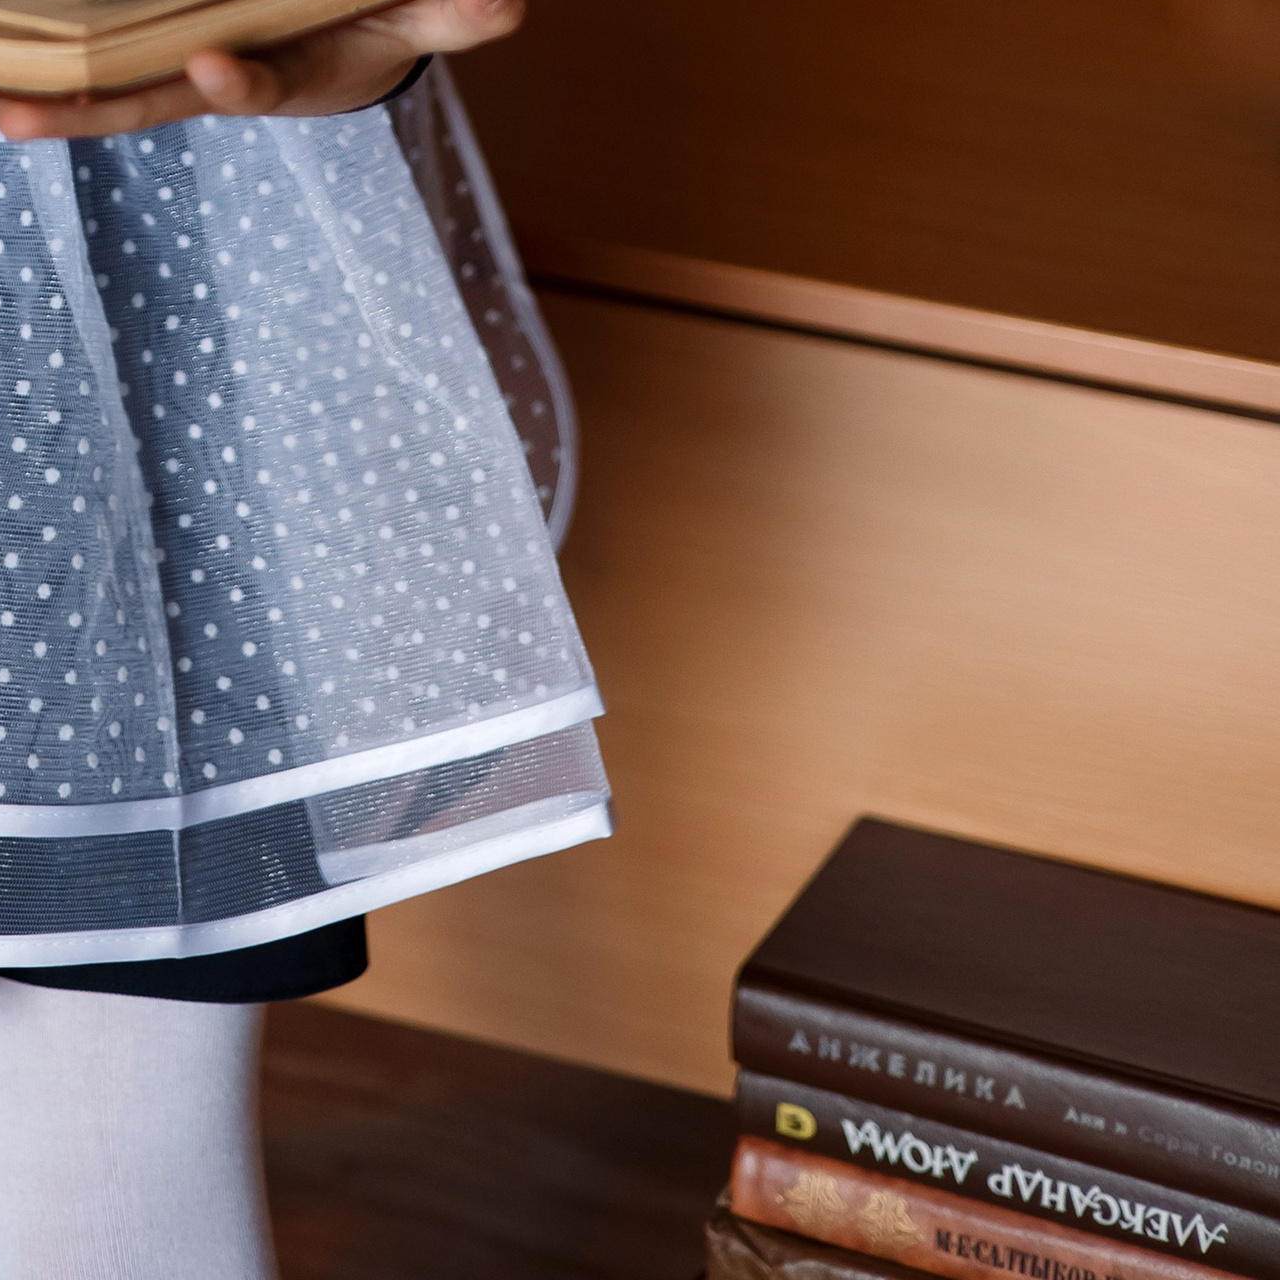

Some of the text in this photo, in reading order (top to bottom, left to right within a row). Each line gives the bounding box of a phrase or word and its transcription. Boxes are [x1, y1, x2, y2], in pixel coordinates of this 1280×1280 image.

[788, 1029, 1027, 1110] АНЖЕЛИКА
[840, 1117, 1229, 1255] АЛЕКСАНДР ДЮМА
